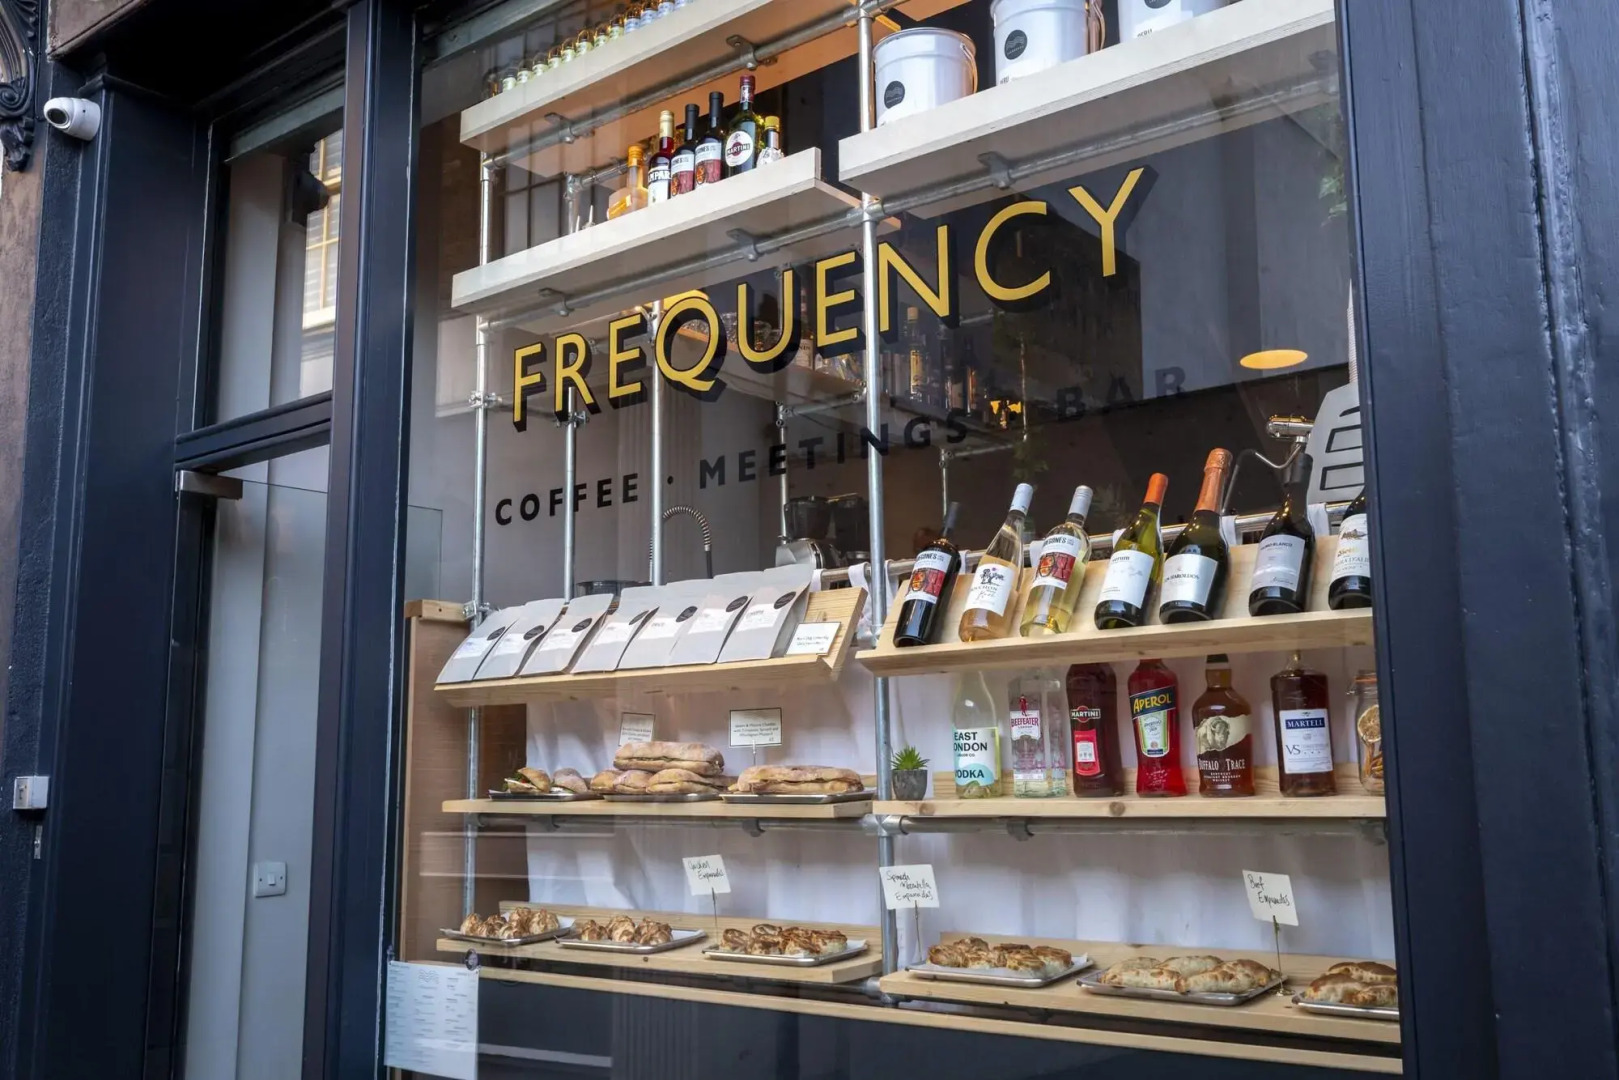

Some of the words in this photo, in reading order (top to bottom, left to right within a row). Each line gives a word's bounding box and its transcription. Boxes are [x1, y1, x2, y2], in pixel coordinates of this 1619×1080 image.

[513, 165, 1152, 429] FREQUENCY
[494, 472, 639, 526] COFFEE
[699, 407, 968, 490] MEETINGS
[1056, 365, 1187, 423] BAR
[1133, 692, 1172, 714] APEROL
[1010, 717, 1039, 728] BEEFEATER
[1286, 719, 1324, 729] MARTELL
[954, 731, 978, 741] EAST
[1286, 744, 1301, 756] VS
[1225, 758, 1246, 771] TRACE
